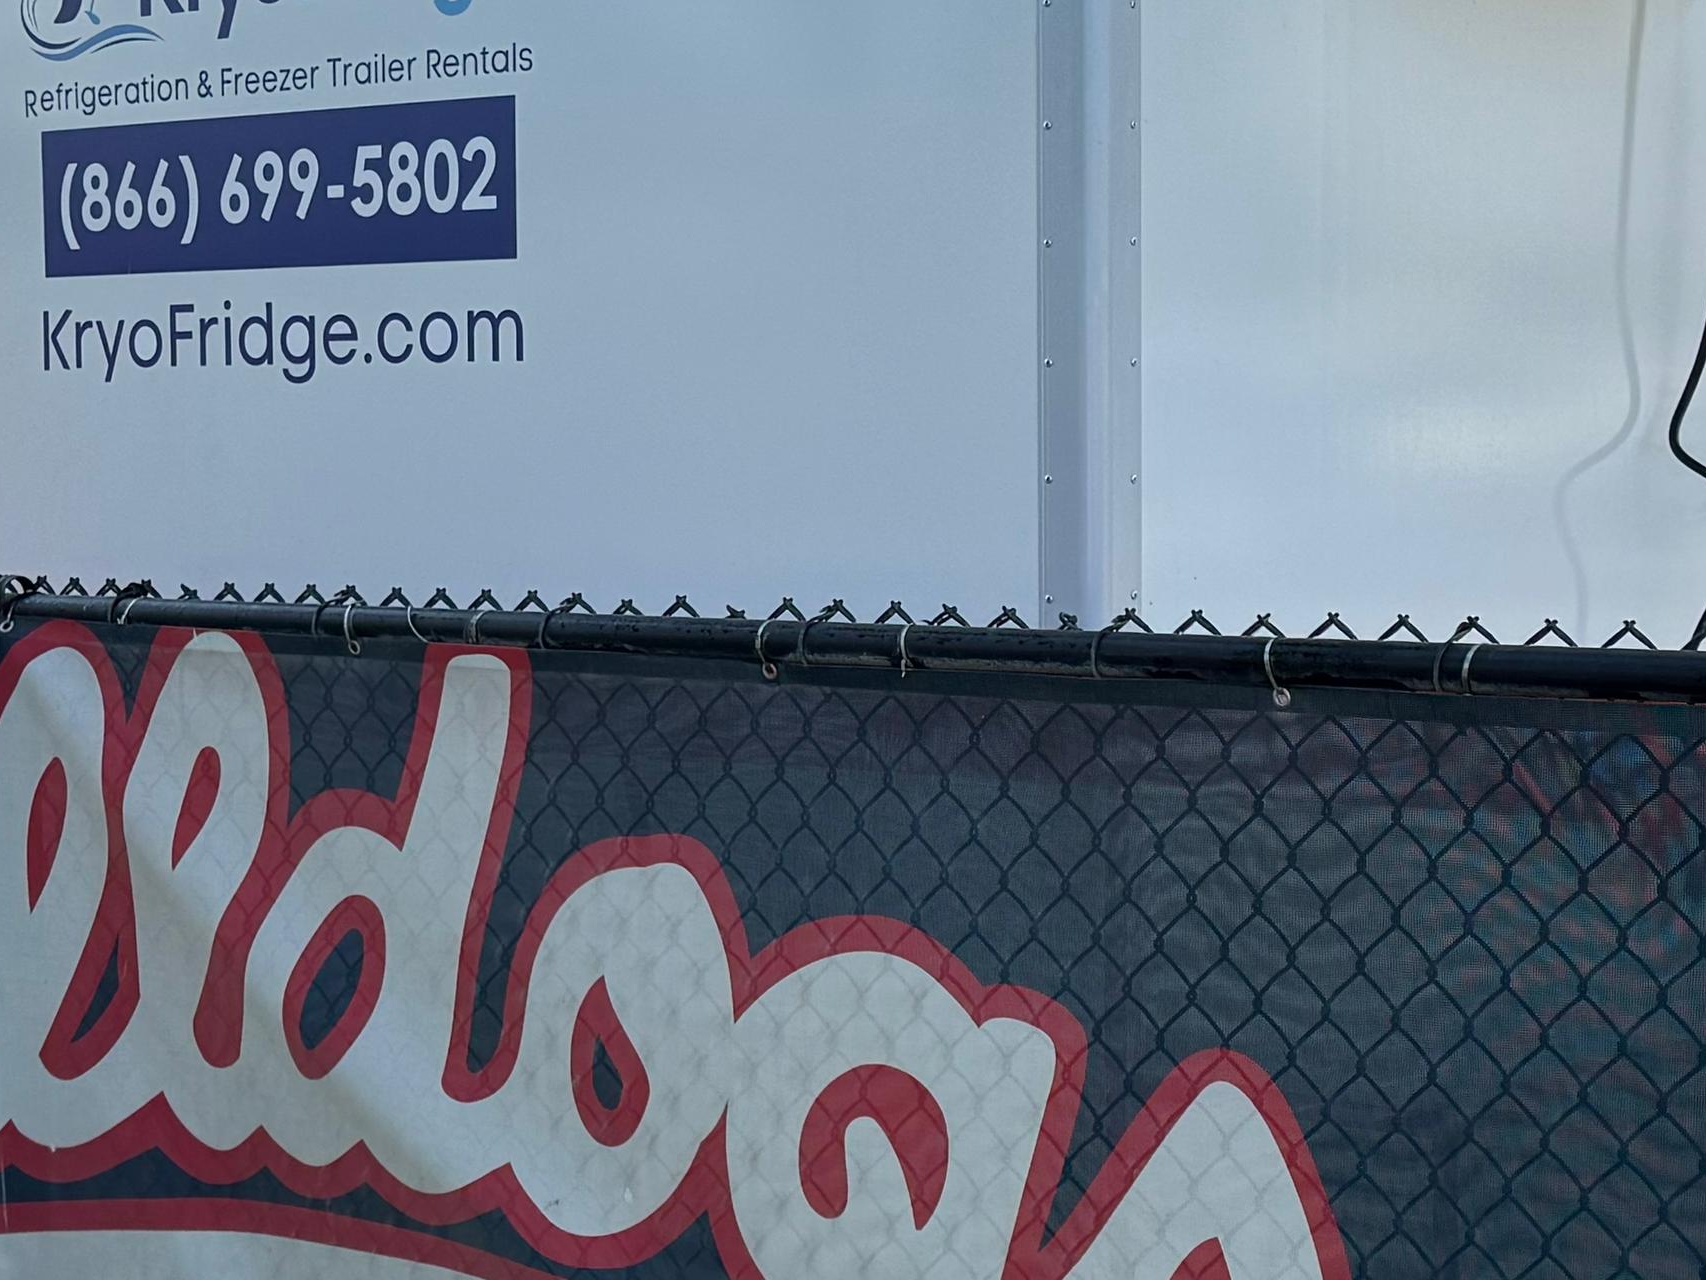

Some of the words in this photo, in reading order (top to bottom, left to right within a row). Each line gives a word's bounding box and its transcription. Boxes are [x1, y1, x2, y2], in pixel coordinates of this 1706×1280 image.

[24, 73, 189, 119] Refrigeration
[197, 70, 214, 98] &
[220, 65, 320, 97] Freezer
[326, 52, 418, 88] Trailer
[426, 41, 534, 79] Rentals
[59, 154, 199, 250] (866)
[219, 135, 499, 225] 699-5802
[41, 299, 525, 384] KryoFridge.com
